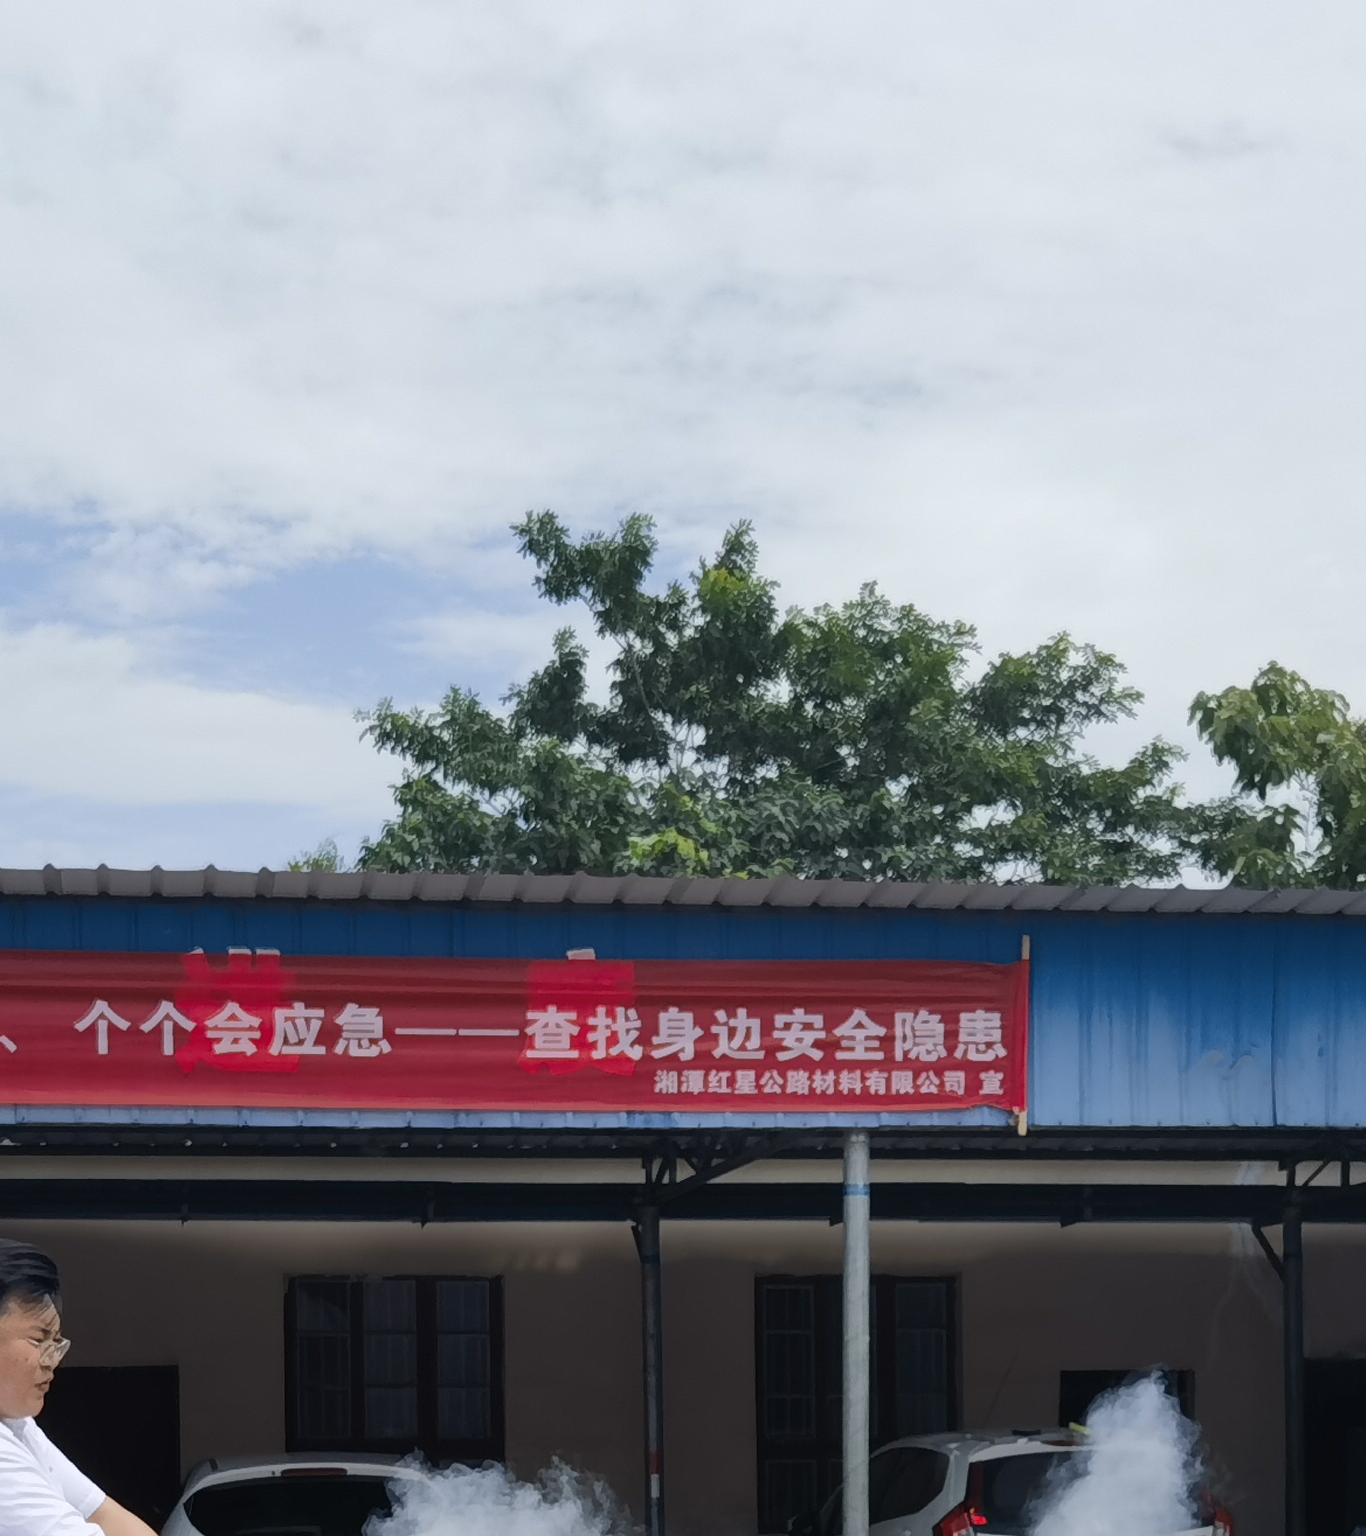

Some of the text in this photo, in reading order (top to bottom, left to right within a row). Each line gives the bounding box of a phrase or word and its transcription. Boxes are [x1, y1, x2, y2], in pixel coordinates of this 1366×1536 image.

[654, 1069, 1005, 1096] 湘潭红星公路材料有限公司 宣
